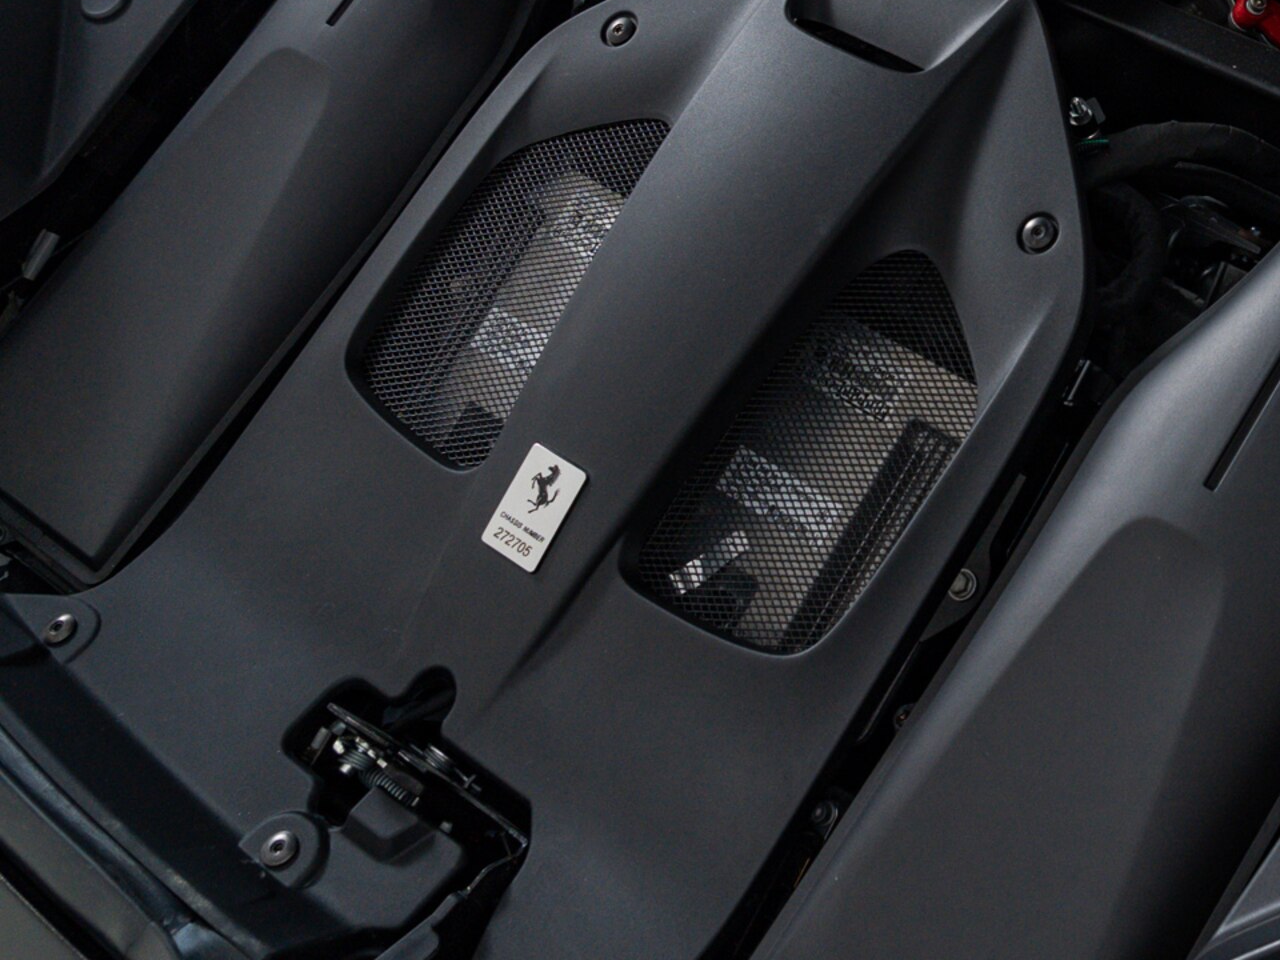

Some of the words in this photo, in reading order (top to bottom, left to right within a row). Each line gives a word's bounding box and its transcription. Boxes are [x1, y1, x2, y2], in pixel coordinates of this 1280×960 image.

[493, 527, 533, 557] 272705
[500, 511, 523, 529] CHASSIS
[522, 525, 545, 543] NUMBER
